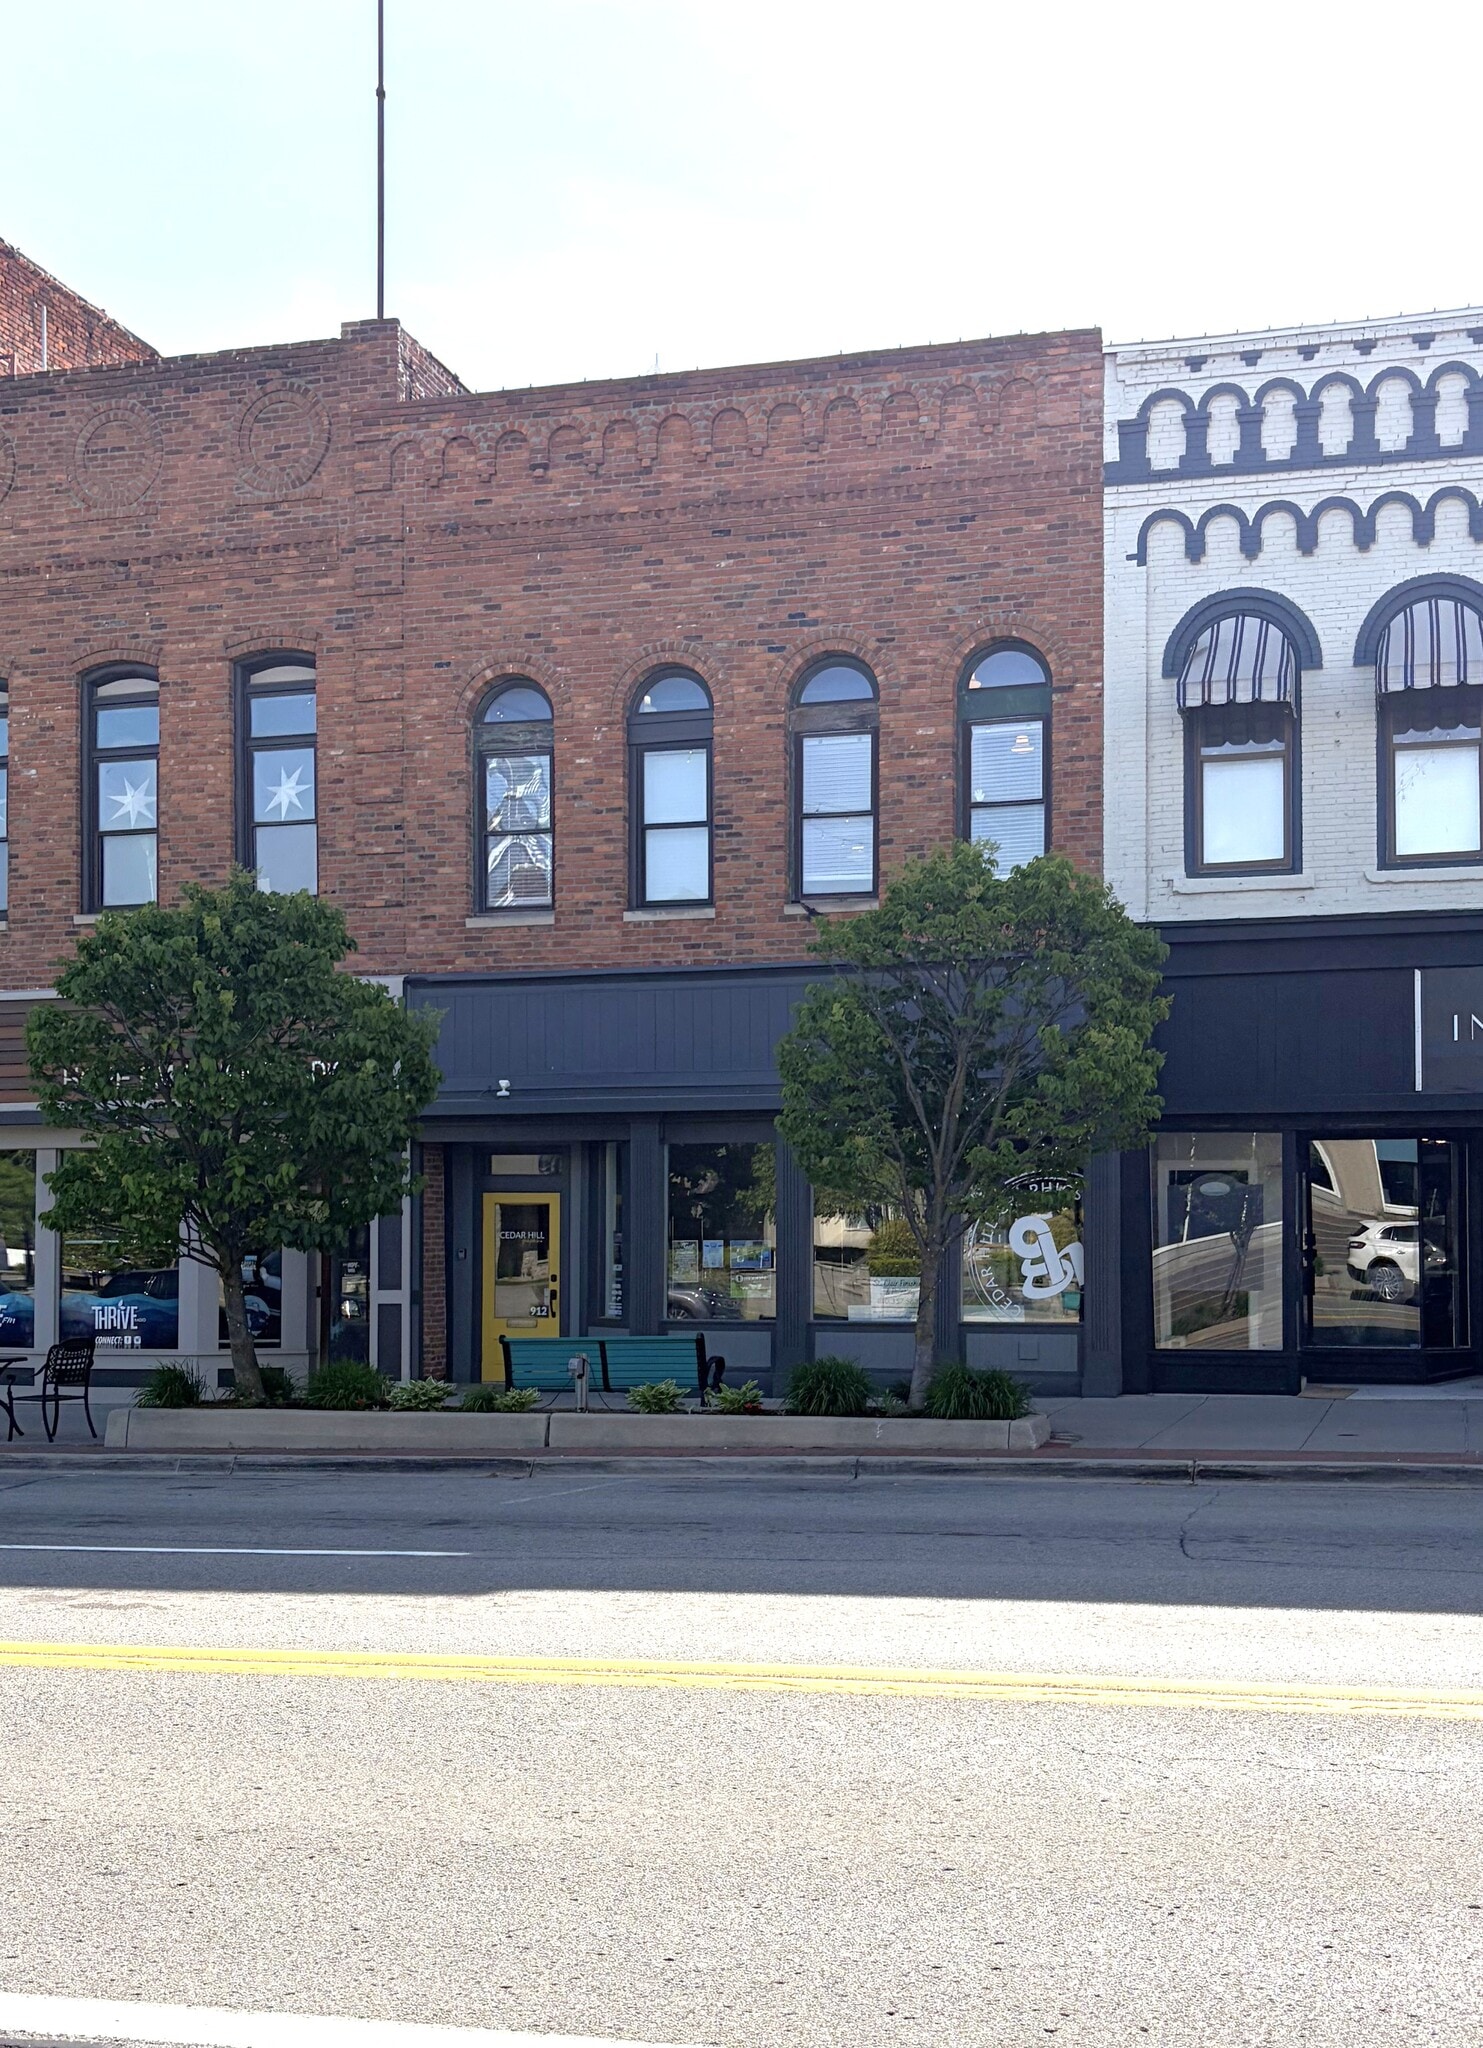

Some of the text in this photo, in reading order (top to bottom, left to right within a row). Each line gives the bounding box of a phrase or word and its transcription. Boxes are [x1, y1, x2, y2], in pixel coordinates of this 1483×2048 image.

[499, 1231, 545, 1239] CEDAR HILL
[981, 1266, 1021, 1317] CEDAR
[91, 1304, 139, 1330] THRIVE
[530, 1306, 548, 1316] 912
